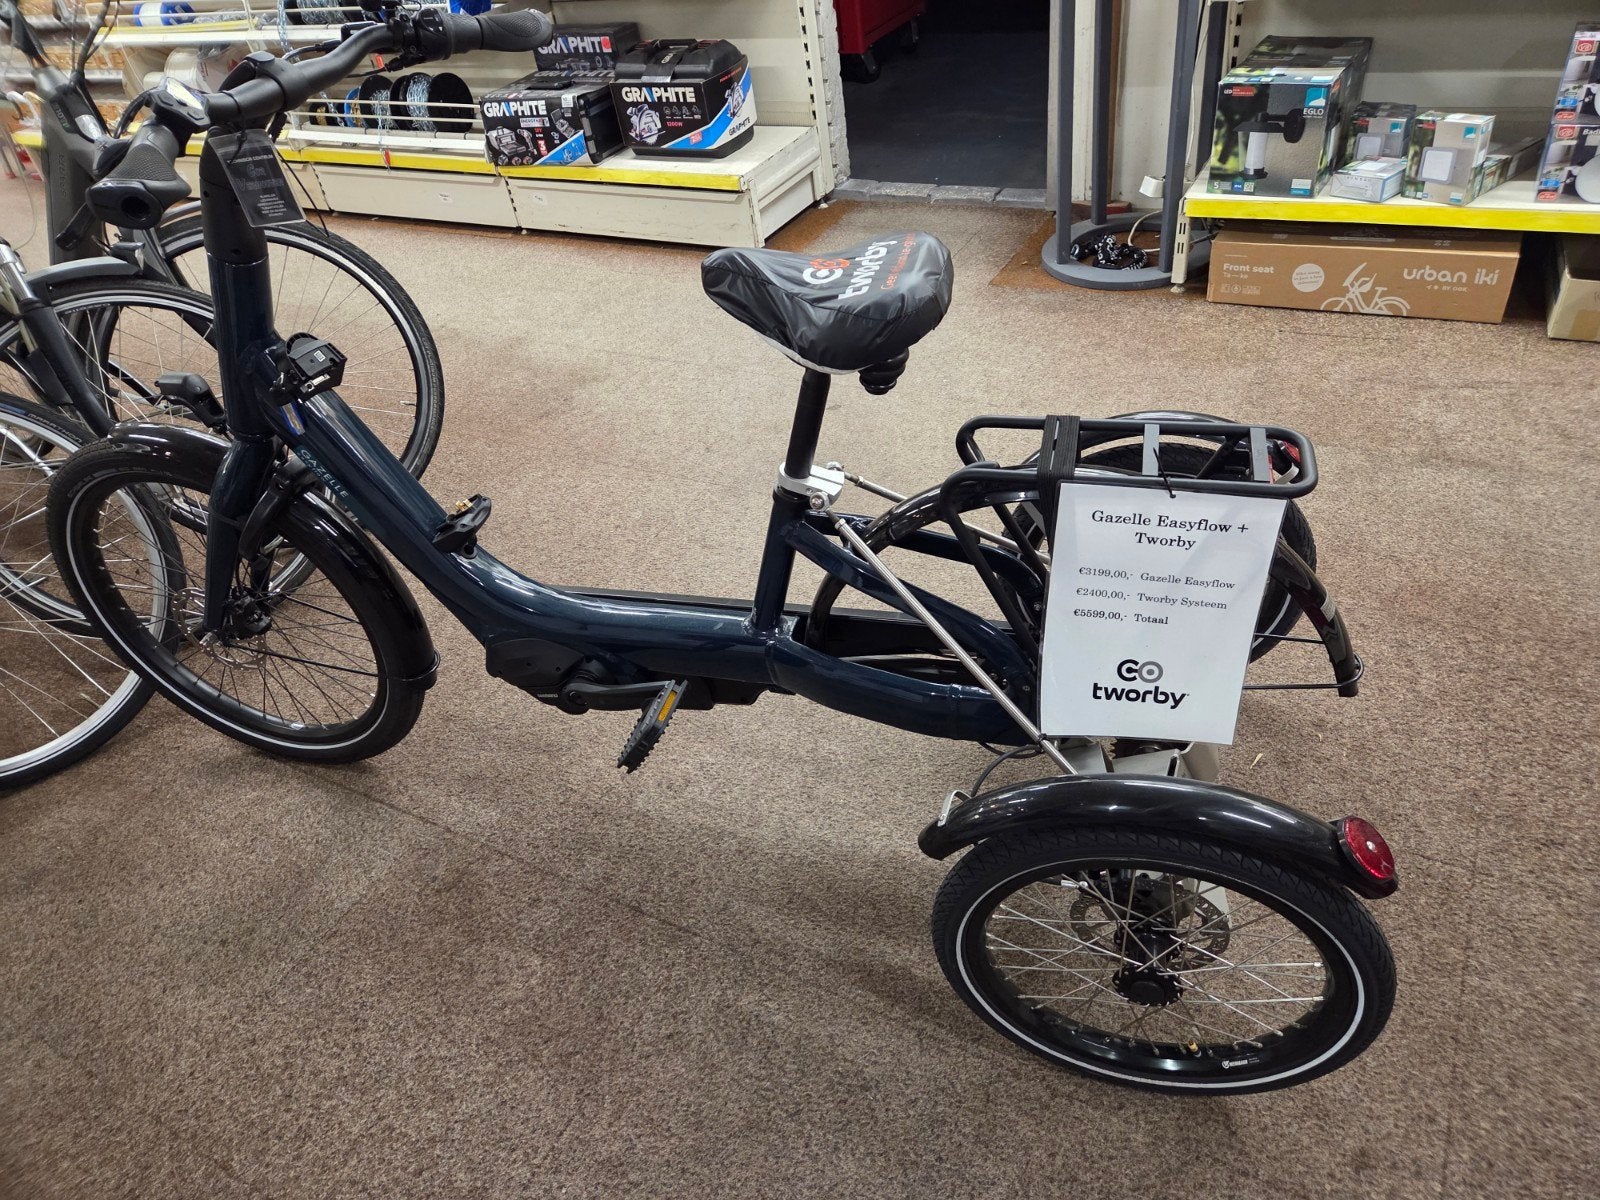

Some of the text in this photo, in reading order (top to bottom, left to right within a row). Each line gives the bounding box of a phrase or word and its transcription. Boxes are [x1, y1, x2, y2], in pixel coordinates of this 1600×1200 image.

[621, 86, 697, 103] GRAPHITE
[483, 100, 548, 118] GRAPHITE
[1303, 107, 1325, 116] EGLO
[838, 240, 898, 299] tworby
[1223, 263, 1275, 274] Front seat
[1403, 265, 1501, 286] urban iki
[301, 449, 350, 498] GAZELLE
[1091, 510, 1249, 534] Gazelle Easyflow +
[1135, 532, 1196, 550] Tworby
[1140, 572, 1181, 585] Gazelle
[1185, 577, 1235, 590] Easyflow
[1137, 593, 1178, 606] Tworby
[1181, 597, 1227, 609] Systeem
[1134, 613, 1169, 625] Totaal
[1092, 682, 1187, 709] tworby
